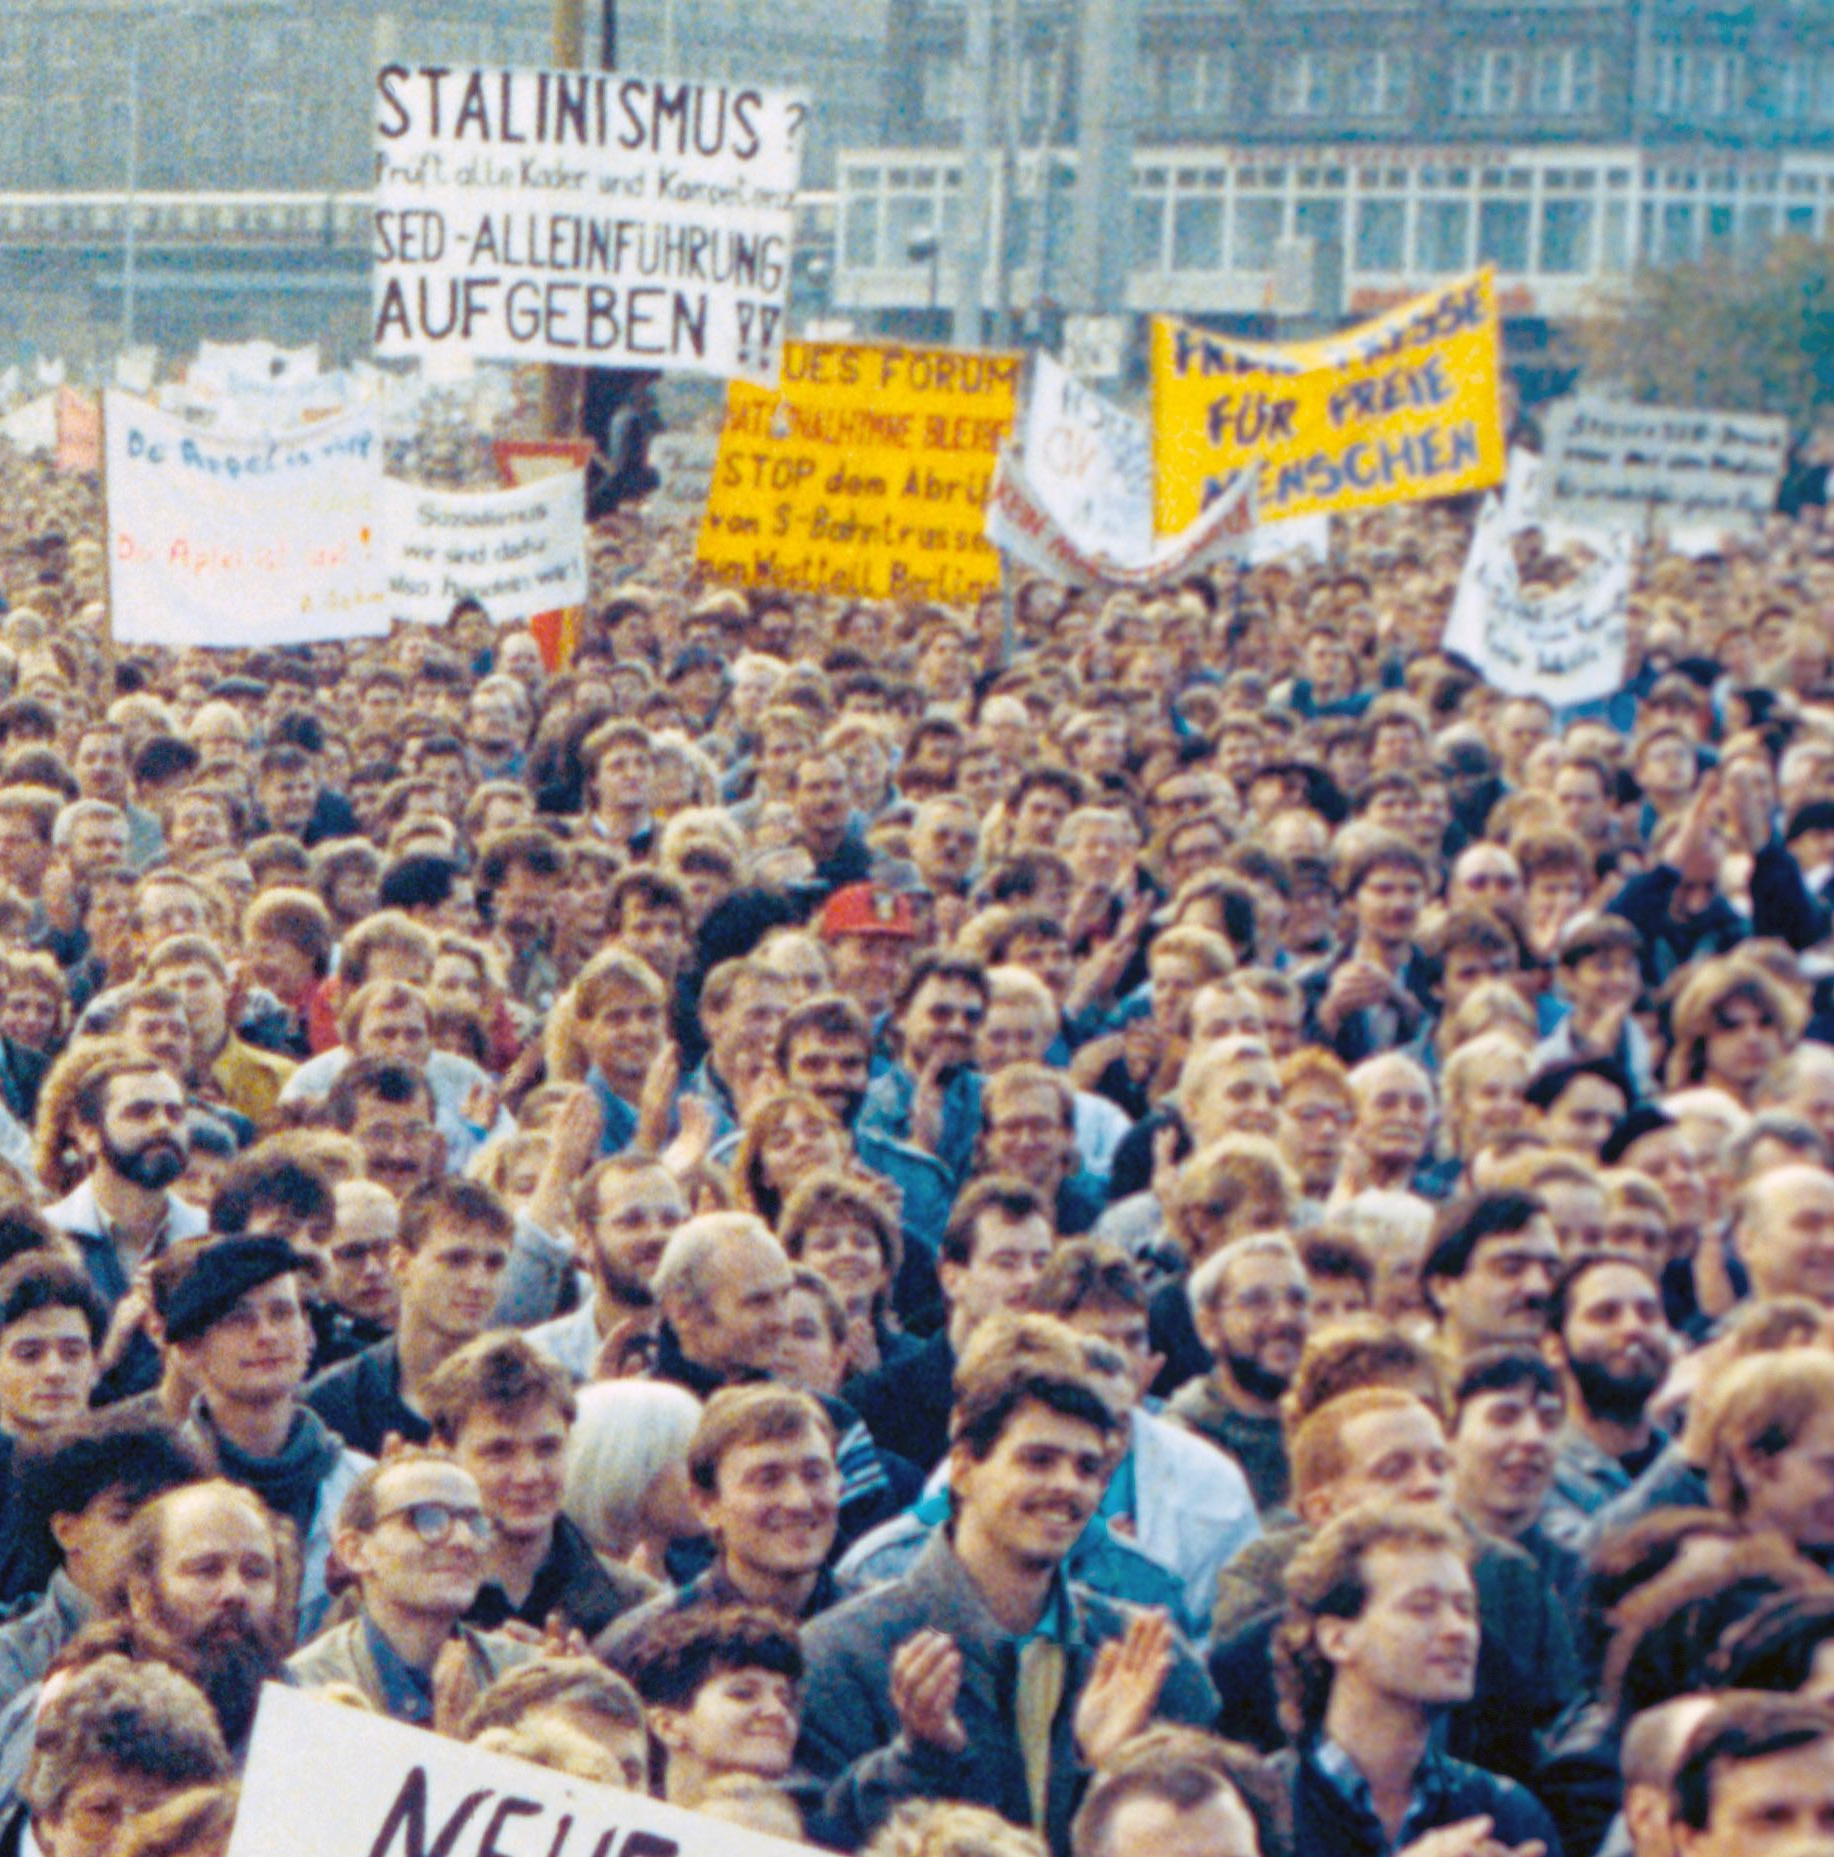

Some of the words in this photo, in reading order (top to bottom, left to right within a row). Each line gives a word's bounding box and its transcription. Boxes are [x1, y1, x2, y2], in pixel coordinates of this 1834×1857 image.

[377, 64, 763, 160] STALINISMUS
[598, 171, 645, 197] und
[374, 277, 708, 358] AUFGEBEN
[880, 350, 1018, 396] FORUM
[1208, 393, 1297, 446] FÜR
[1329, 355, 1453, 429] FREIE
[722, 452, 817, 491] STOP
[825, 461, 887, 497] dem
